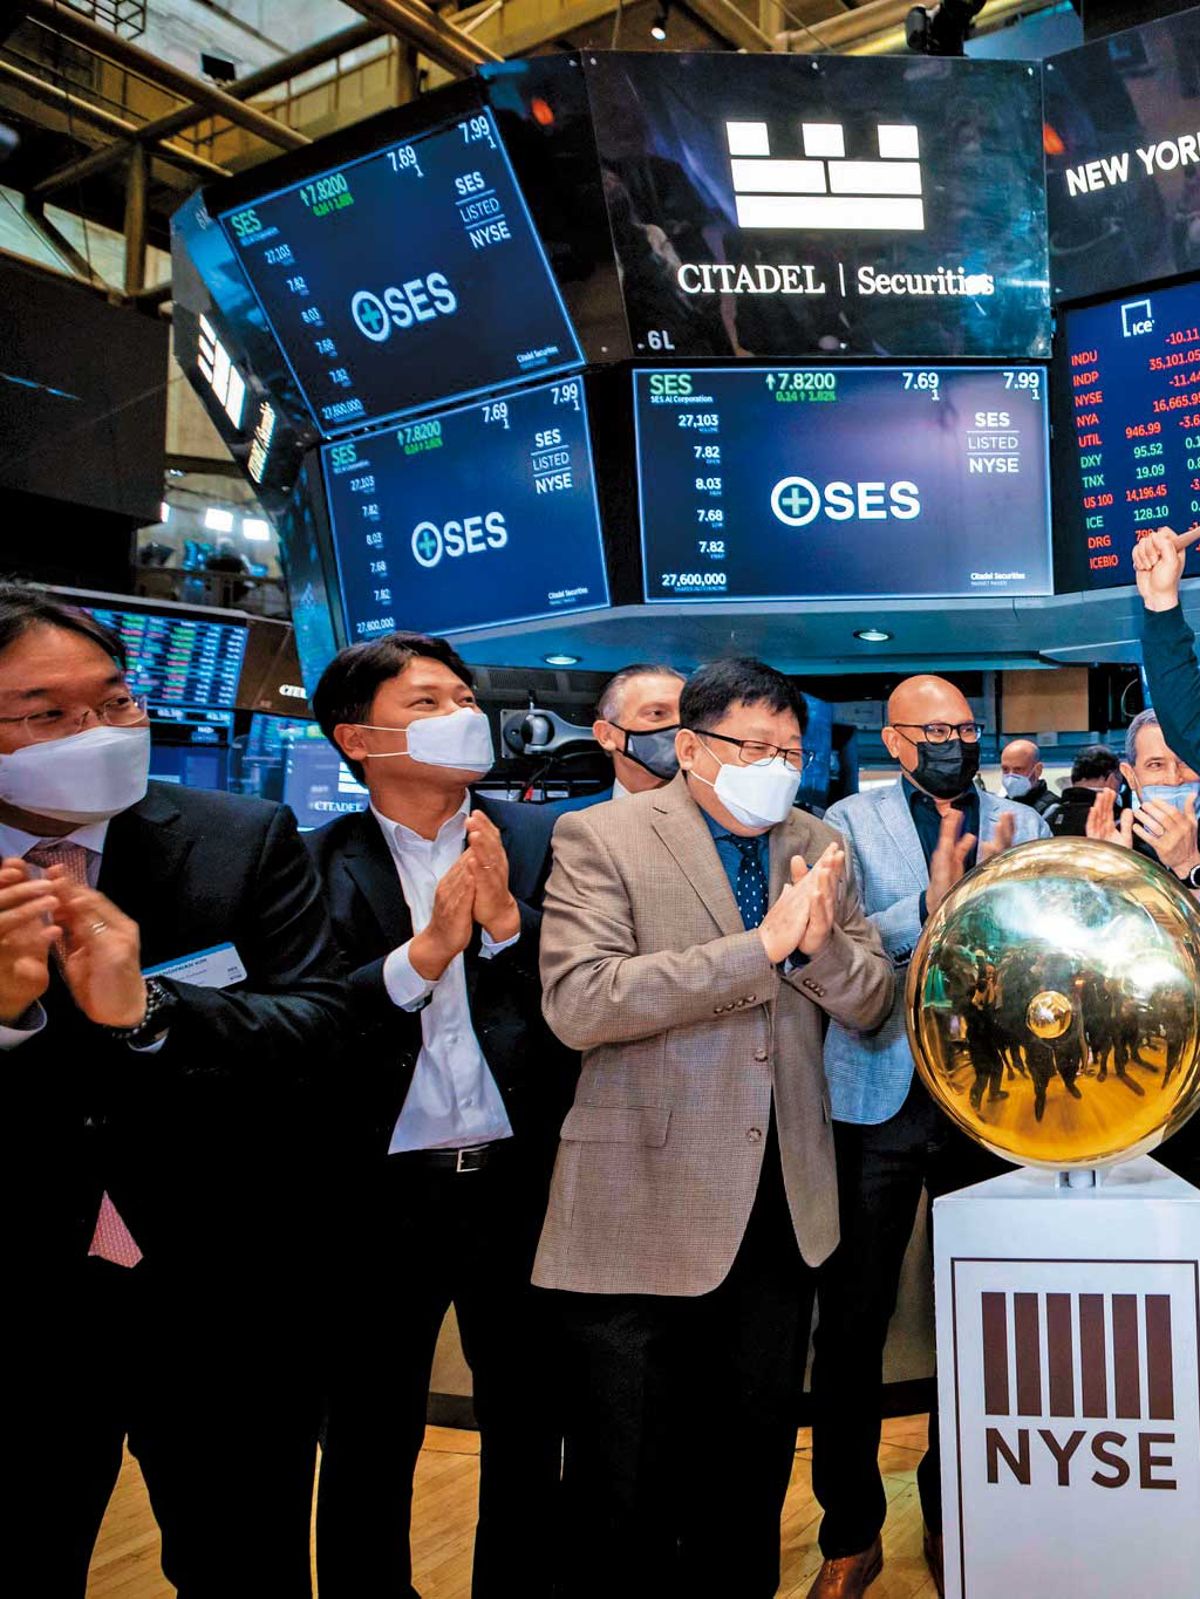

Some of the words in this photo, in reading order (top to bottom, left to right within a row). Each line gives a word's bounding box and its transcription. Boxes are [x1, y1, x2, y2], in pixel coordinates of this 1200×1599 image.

[458, 115, 490, 143] 7.99
[387, 145, 417, 172] 7.69
[455, 171, 485, 195] SES
[1065, 153, 1129, 196] NEW
[306, 173, 348, 204] 7.8200
[460, 197, 499, 223] LISTED
[231, 209, 262, 237] SES
[469, 221, 512, 249] NYSE
[677, 263, 826, 294] CITADEL
[384, 271, 458, 330] SES
[648, 330, 675, 350] 6L
[1165, 327, 1200, 345] -10.11
[1072, 350, 1098, 366] INDU
[650, 374, 692, 395] SES
[778, 373, 836, 390] 7.8200
[902, 372, 940, 390] 7.69
[1003, 372, 1040, 390] 7.99
[1073, 371, 1099, 387] INDP
[551, 383, 578, 405] 7.99
[931, 389, 940, 401] 1
[1032, 389, 1040, 400] 1
[1074, 391, 1103, 408] NYSE
[482, 402, 508, 423] 7.69
[678, 414, 719, 428] 27,103
[975, 412, 1010, 428] SES
[1076, 413, 1099, 427] NYA
[404, 420, 441, 443] 7.8200
[535, 428, 561, 448] SES
[1078, 433, 1103, 448] UTIL
[1125, 422, 1161, 439] 946.99
[694, 445, 720, 459] 7.82
[968, 436, 1019, 450] LISTED
[331, 444, 357, 466] SES
[532, 452, 569, 471] LISTED
[969, 457, 1020, 473] NYSE
[1080, 454, 1103, 469] DXY
[1134, 443, 1163, 459] 95.52
[535, 472, 573, 494] NYSE
[695, 478, 722, 490] 8.03
[1082, 474, 1105, 489] TNX
[1136, 464, 1165, 480] 19.09
[824, 480, 921, 520] SES
[1084, 496, 1096, 509] US
[1097, 493, 1113, 507] 100
[697, 509, 723, 522] 7.68
[1086, 516, 1104, 529] ICE
[1134, 505, 1169, 522] 128.10
[443, 511, 508, 558] SES
[1088, 534, 1111, 549] DRG
[699, 541, 725, 553] 7.82
[662, 573, 726, 587] 27,600,000
[985, 1428, 1177, 1490] NYSE
